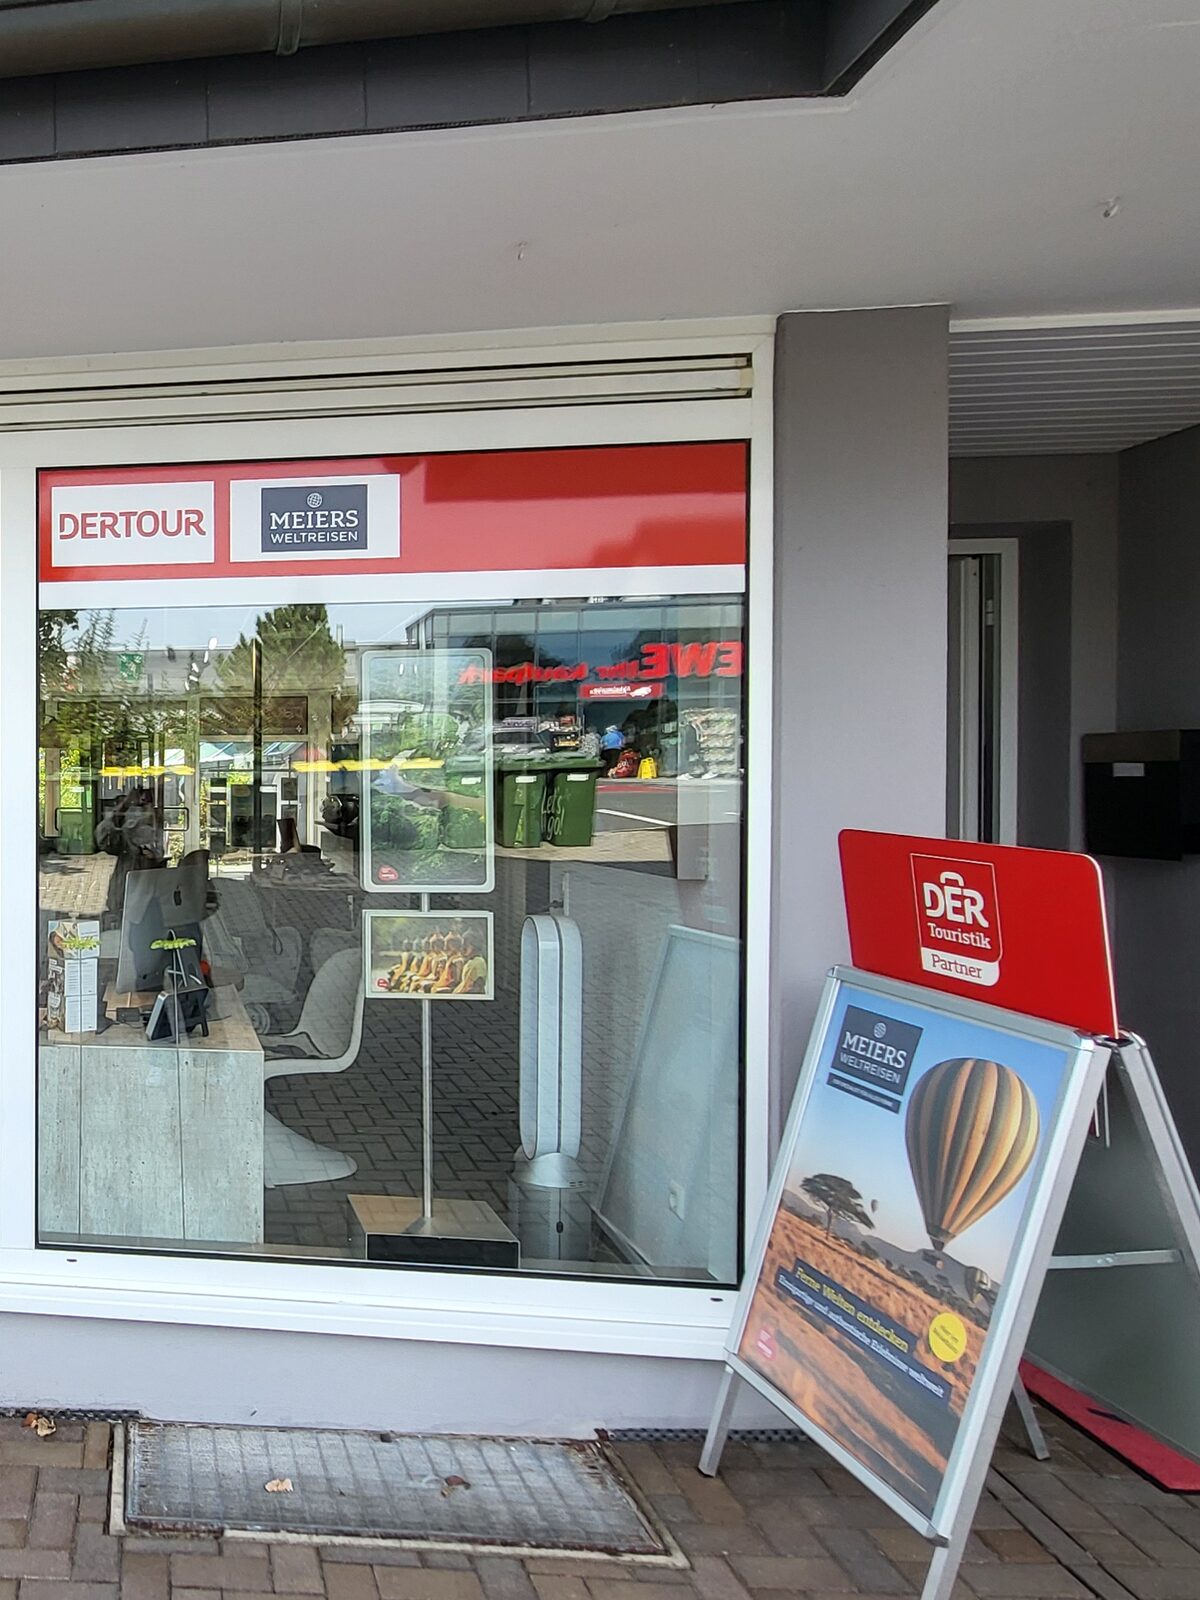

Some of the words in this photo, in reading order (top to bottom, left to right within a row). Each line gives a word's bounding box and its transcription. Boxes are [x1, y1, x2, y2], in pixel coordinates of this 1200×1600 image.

[59, 508, 207, 541] DERTOUR
[269, 510, 359, 530] MEIERS
[270, 531, 358, 544] WELTREISEN
[923, 882, 990, 928] DER
[927, 922, 992, 950] Touristik
[931, 953, 982, 979] Partner
[841, 1031, 907, 1069] MEIERS
[838, 1051, 901, 1084] WELTREISEN
